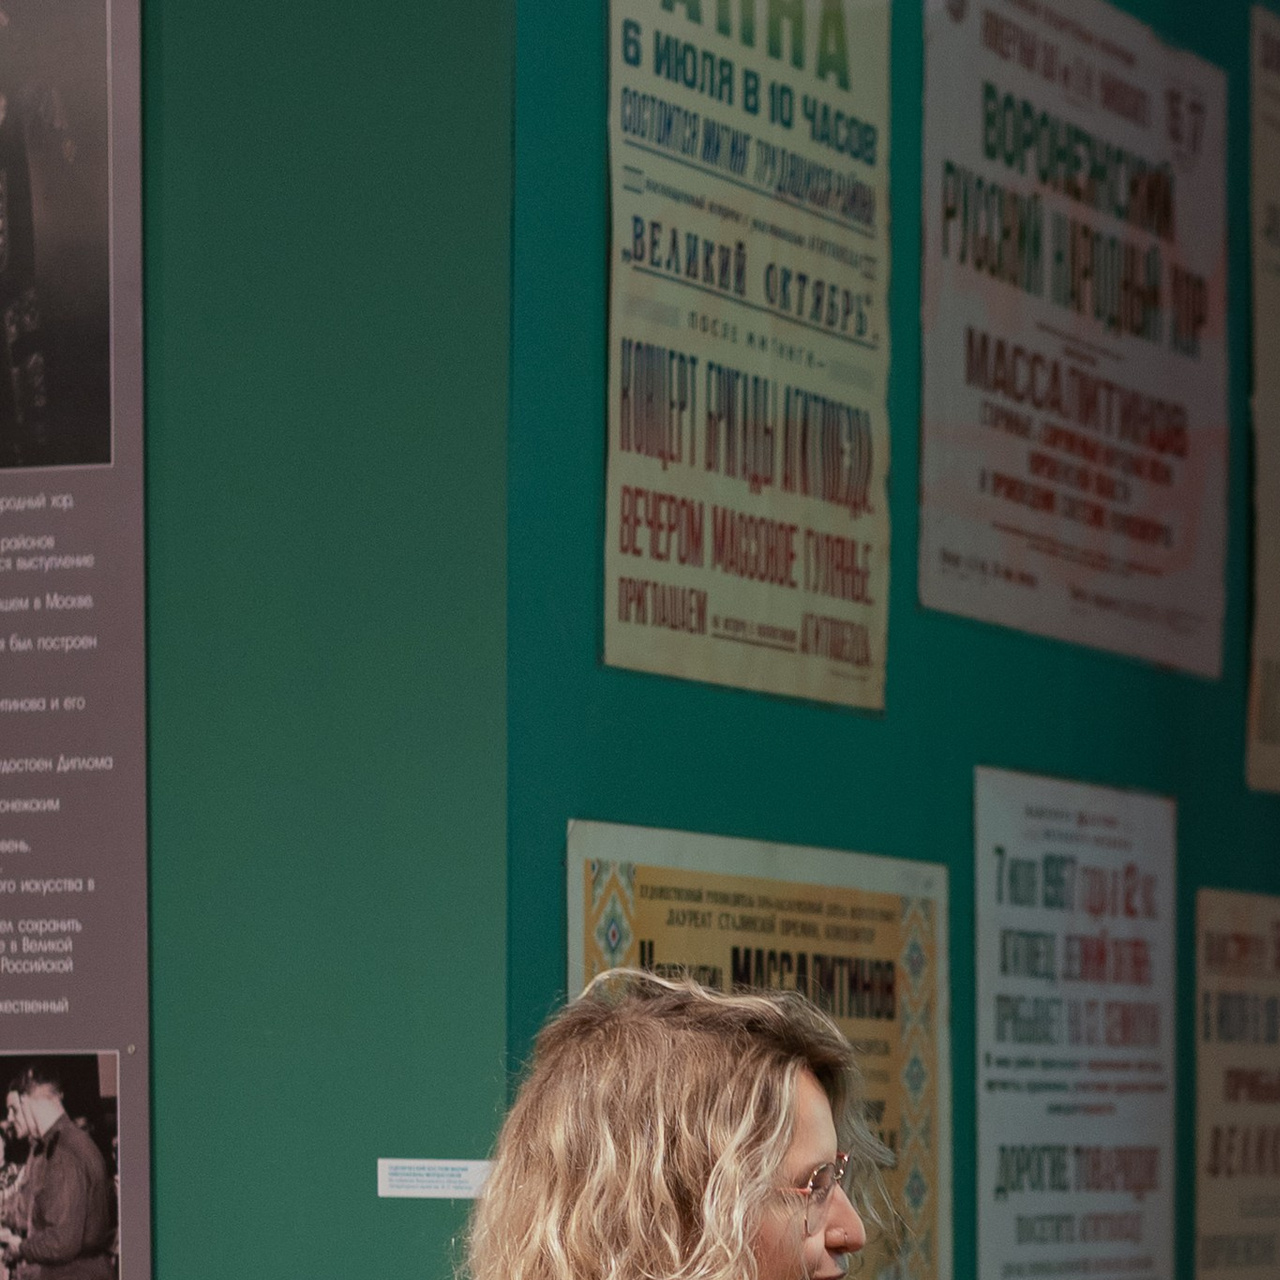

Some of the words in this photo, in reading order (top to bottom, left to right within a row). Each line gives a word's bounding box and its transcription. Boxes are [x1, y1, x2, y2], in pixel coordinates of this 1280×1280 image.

[621, 18, 641, 68] 6
[743, 67, 761, 117] В
[769, 81, 794, 130] 10
[802, 94, 879, 168] ЧАСОВ
